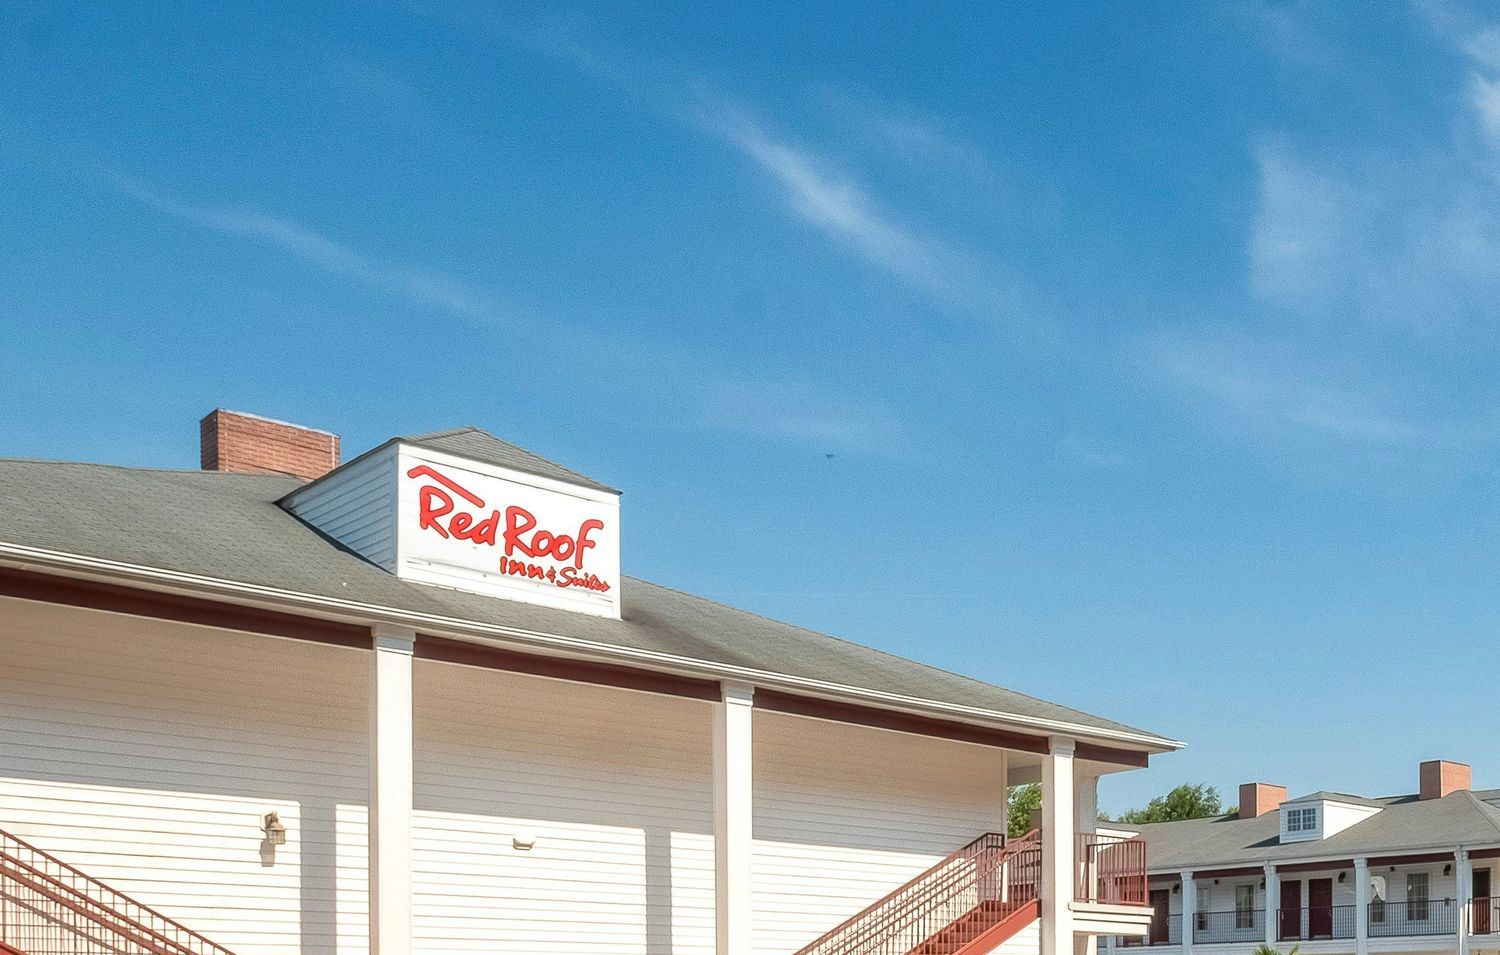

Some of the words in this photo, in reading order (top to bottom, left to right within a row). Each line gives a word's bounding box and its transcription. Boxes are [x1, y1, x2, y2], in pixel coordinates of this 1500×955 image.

[419, 485, 500, 546] Red
[503, 505, 604, 570] Roof
[500, 556, 545, 580] Inn
